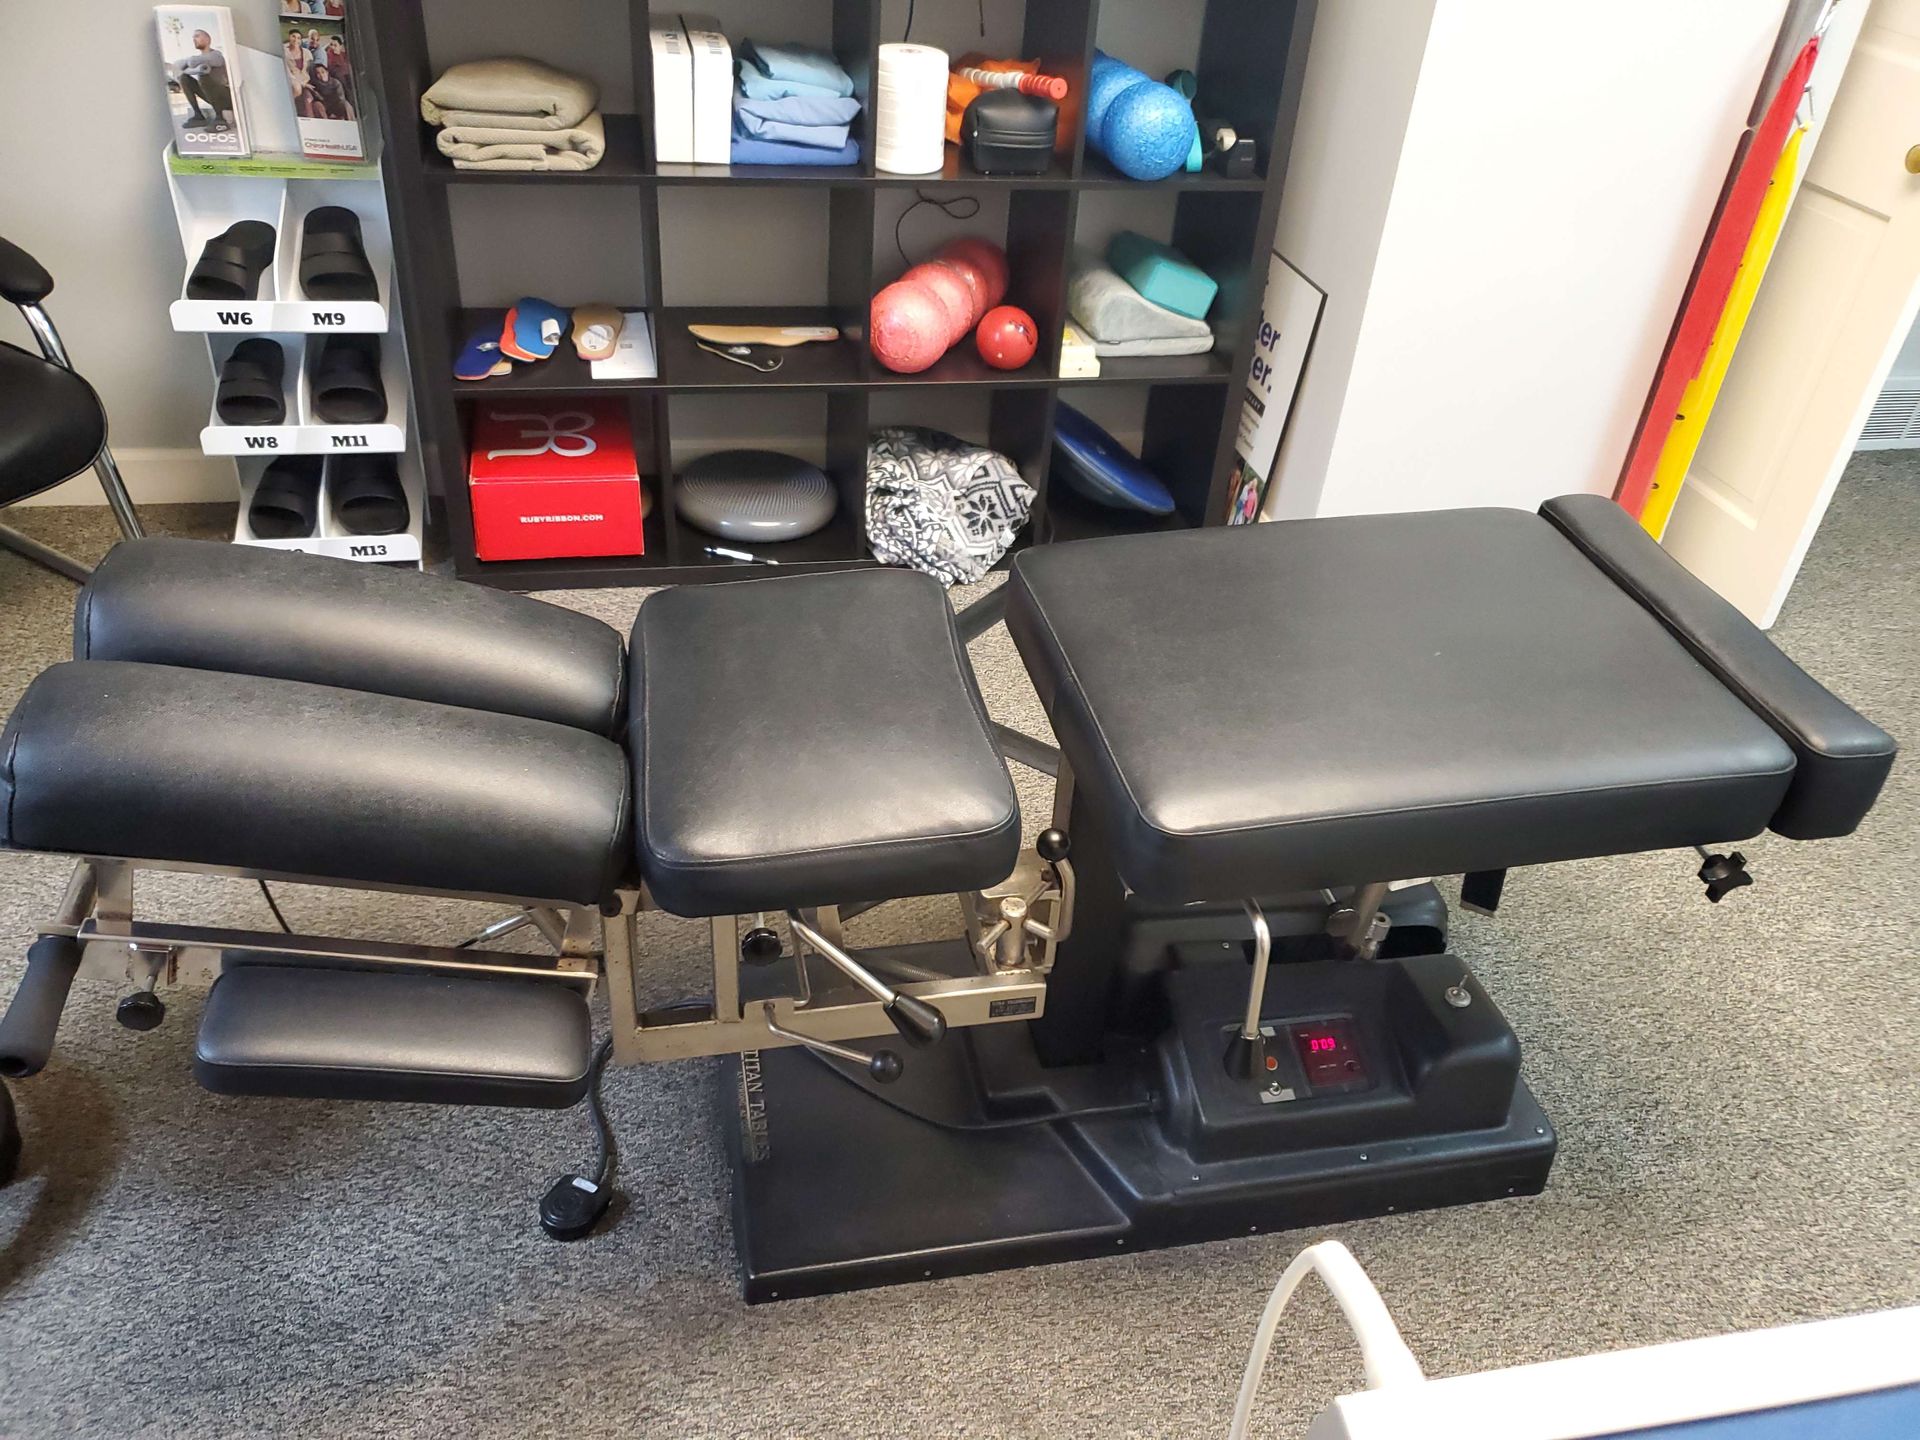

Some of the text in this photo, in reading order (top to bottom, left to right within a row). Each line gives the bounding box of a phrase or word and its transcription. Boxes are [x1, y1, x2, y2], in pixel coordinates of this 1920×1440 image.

[184, 132, 237, 143] OOFOS
[217, 312, 253, 325] W6
[312, 312, 346, 325] M9
[244, 436, 279, 448] W8
[331, 435, 369, 447] M11
[520, 514, 604, 523] RUBYRIBBON.COM
[349, 545, 387, 557] M13
[744, 1049, 763, 1093] TITAN
